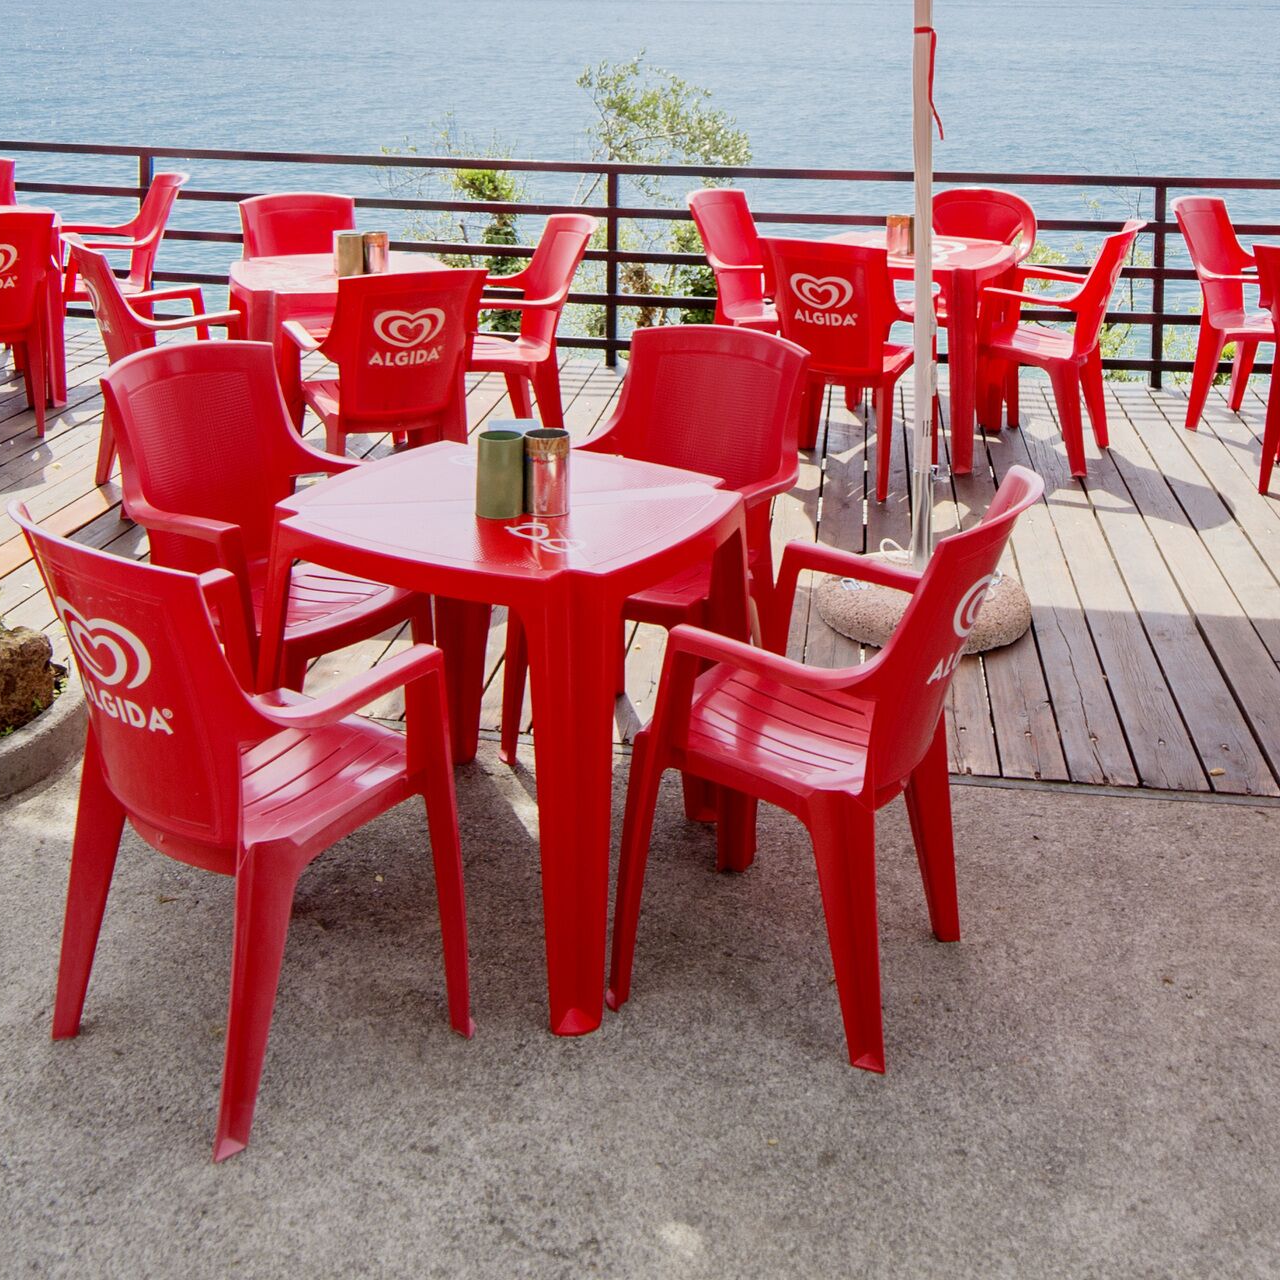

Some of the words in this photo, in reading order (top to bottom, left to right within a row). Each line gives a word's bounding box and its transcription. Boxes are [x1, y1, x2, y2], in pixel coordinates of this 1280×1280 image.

[794, 309, 857, 326] ALGIDA
[369, 348, 440, 366] ALGIDA
[81, 673, 174, 735] ALGIDA
